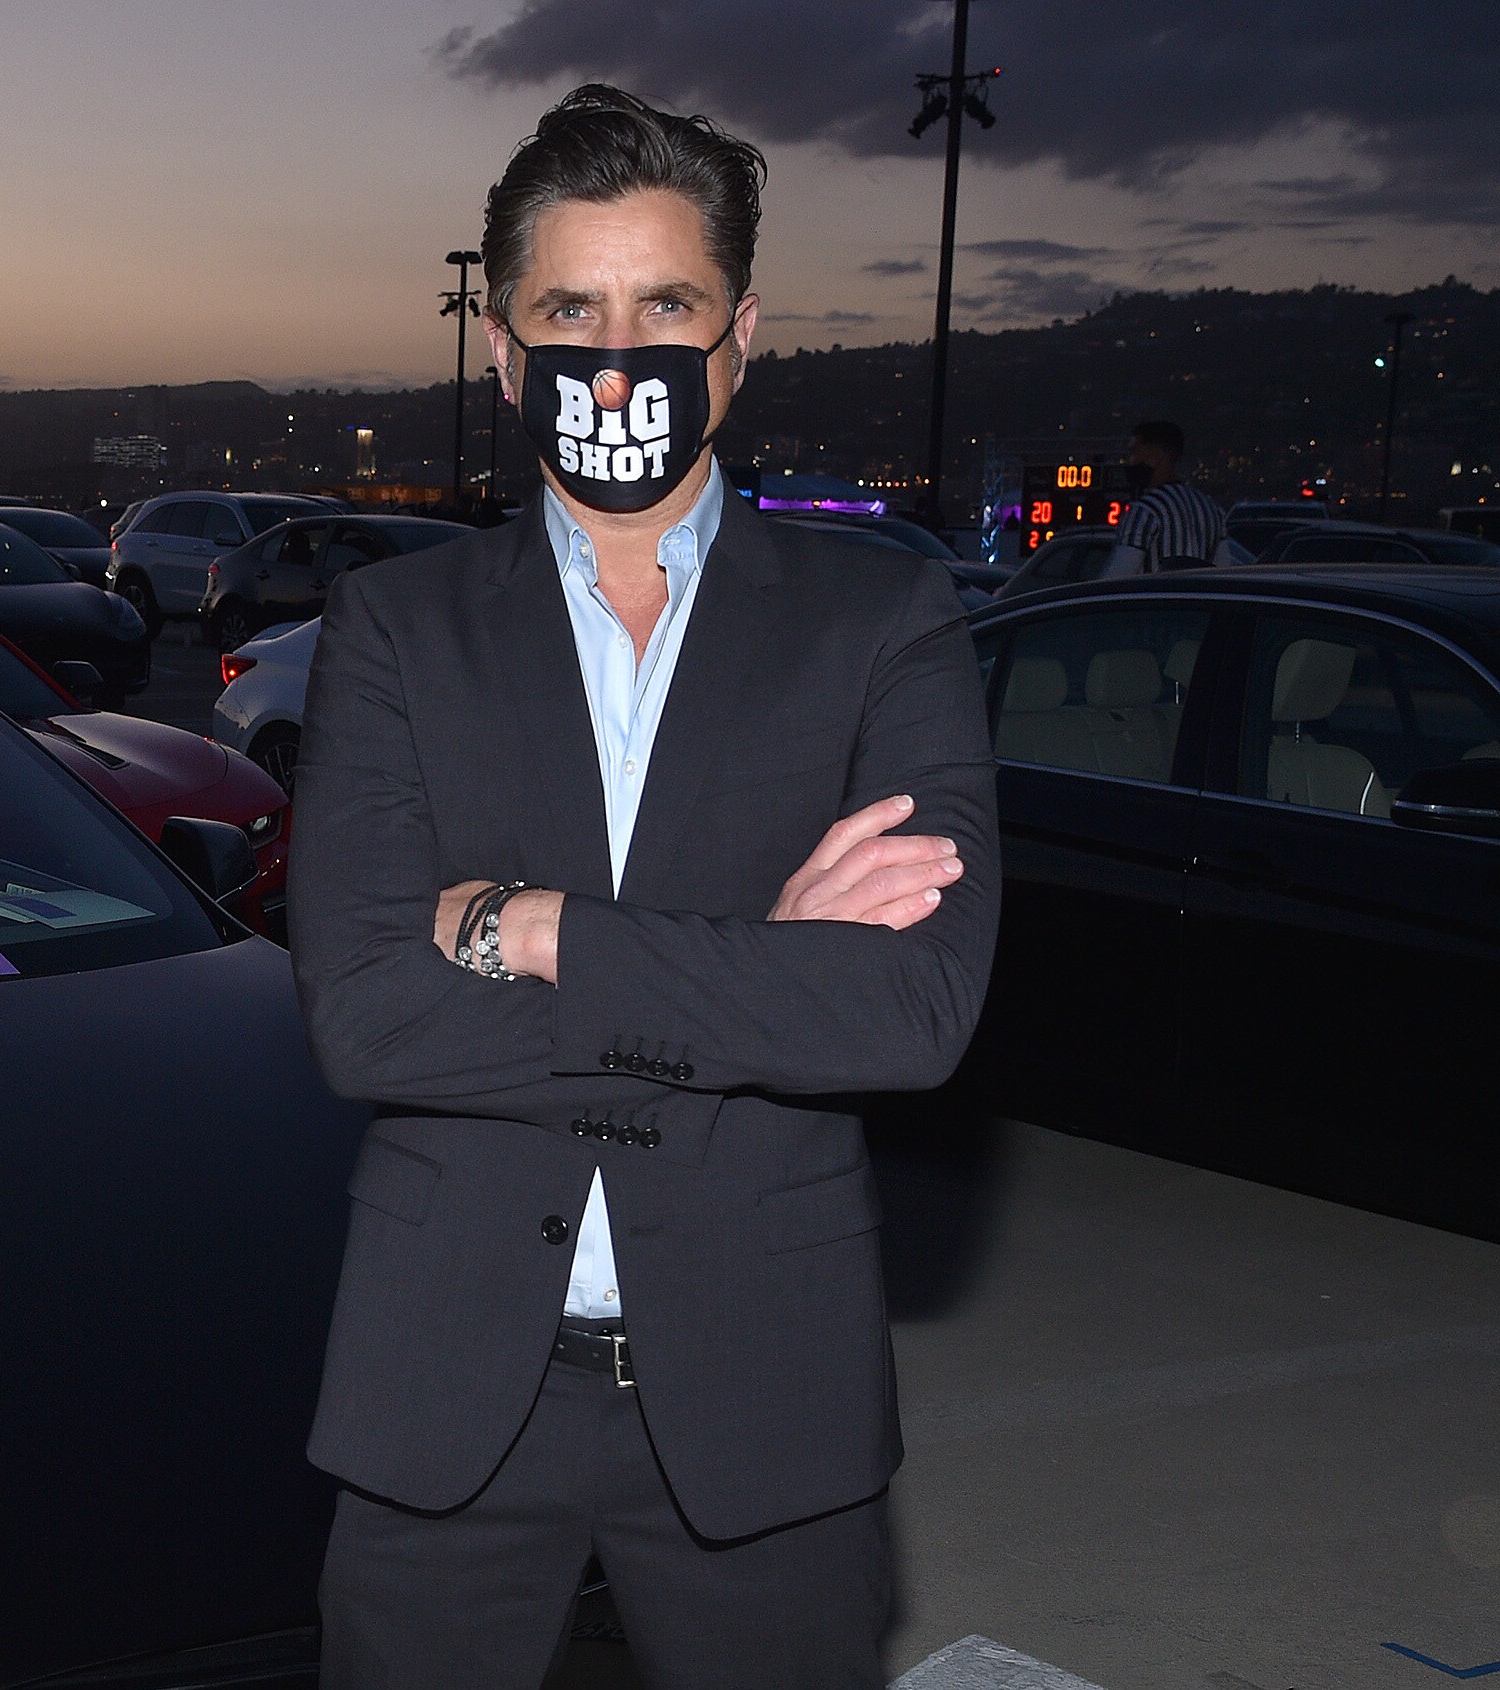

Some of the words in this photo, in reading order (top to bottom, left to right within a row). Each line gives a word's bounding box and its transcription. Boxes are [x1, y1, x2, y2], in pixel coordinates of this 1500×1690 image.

[556, 374, 669, 445] BIG
[557, 436, 670, 482] SHOT
[1057, 465, 1092, 488] 00.0
[1031, 501, 1052, 524] 20
[1077, 505, 1083, 520] 1
